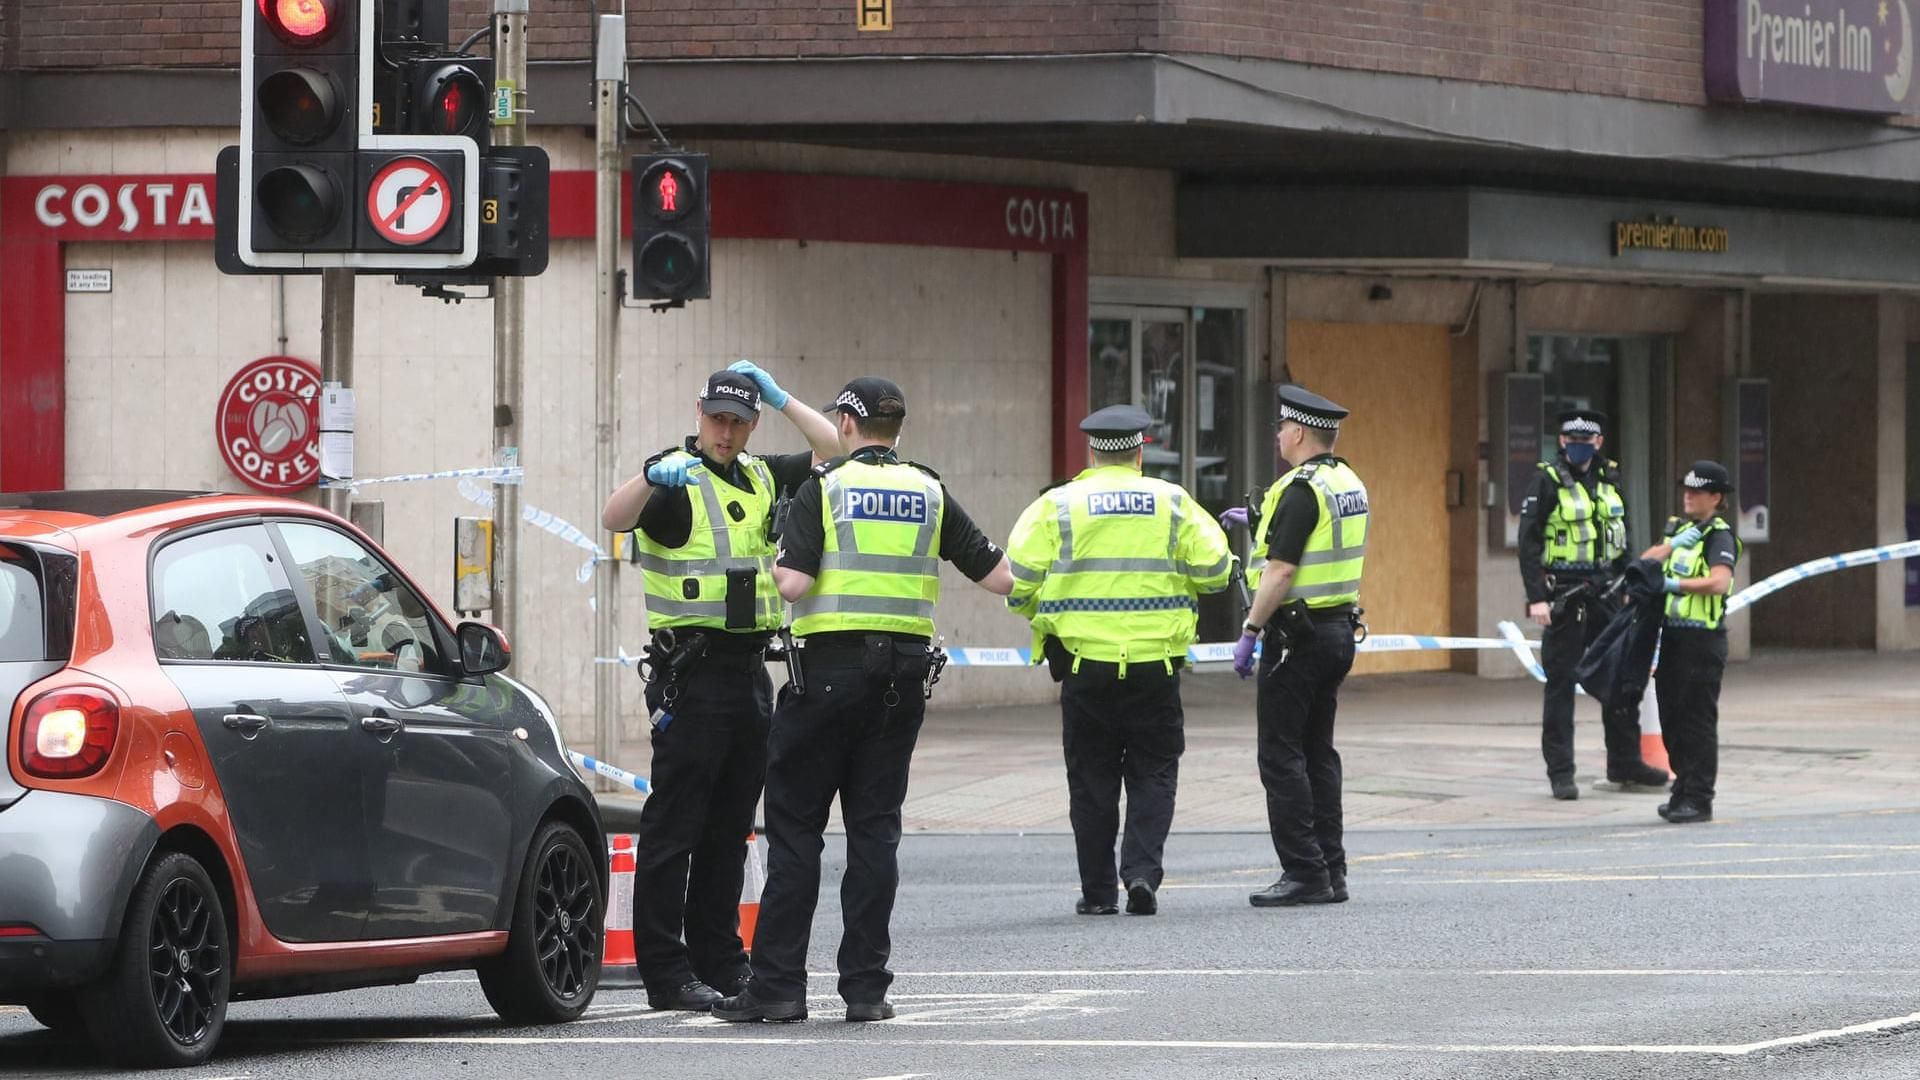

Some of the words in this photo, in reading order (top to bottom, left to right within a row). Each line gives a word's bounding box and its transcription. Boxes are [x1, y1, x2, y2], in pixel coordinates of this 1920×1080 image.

[1747, 0, 1835, 68] Premier
[1839, 8, 1872, 73] Inn
[497, 87, 508, 118] T23
[34, 183, 215, 232] COSTA
[482, 202, 495, 221] 6
[1005, 197, 1075, 244] COSTA
[1616, 215, 1729, 256] premierinn.com
[239, 368, 317, 406] COSTA
[715, 384, 752, 400] POLICE
[231, 437, 320, 481] COFFEE
[846, 491, 923, 518] POLICE
[1088, 493, 1153, 513] POLICE
[979, 651, 1009, 662] POLICE
